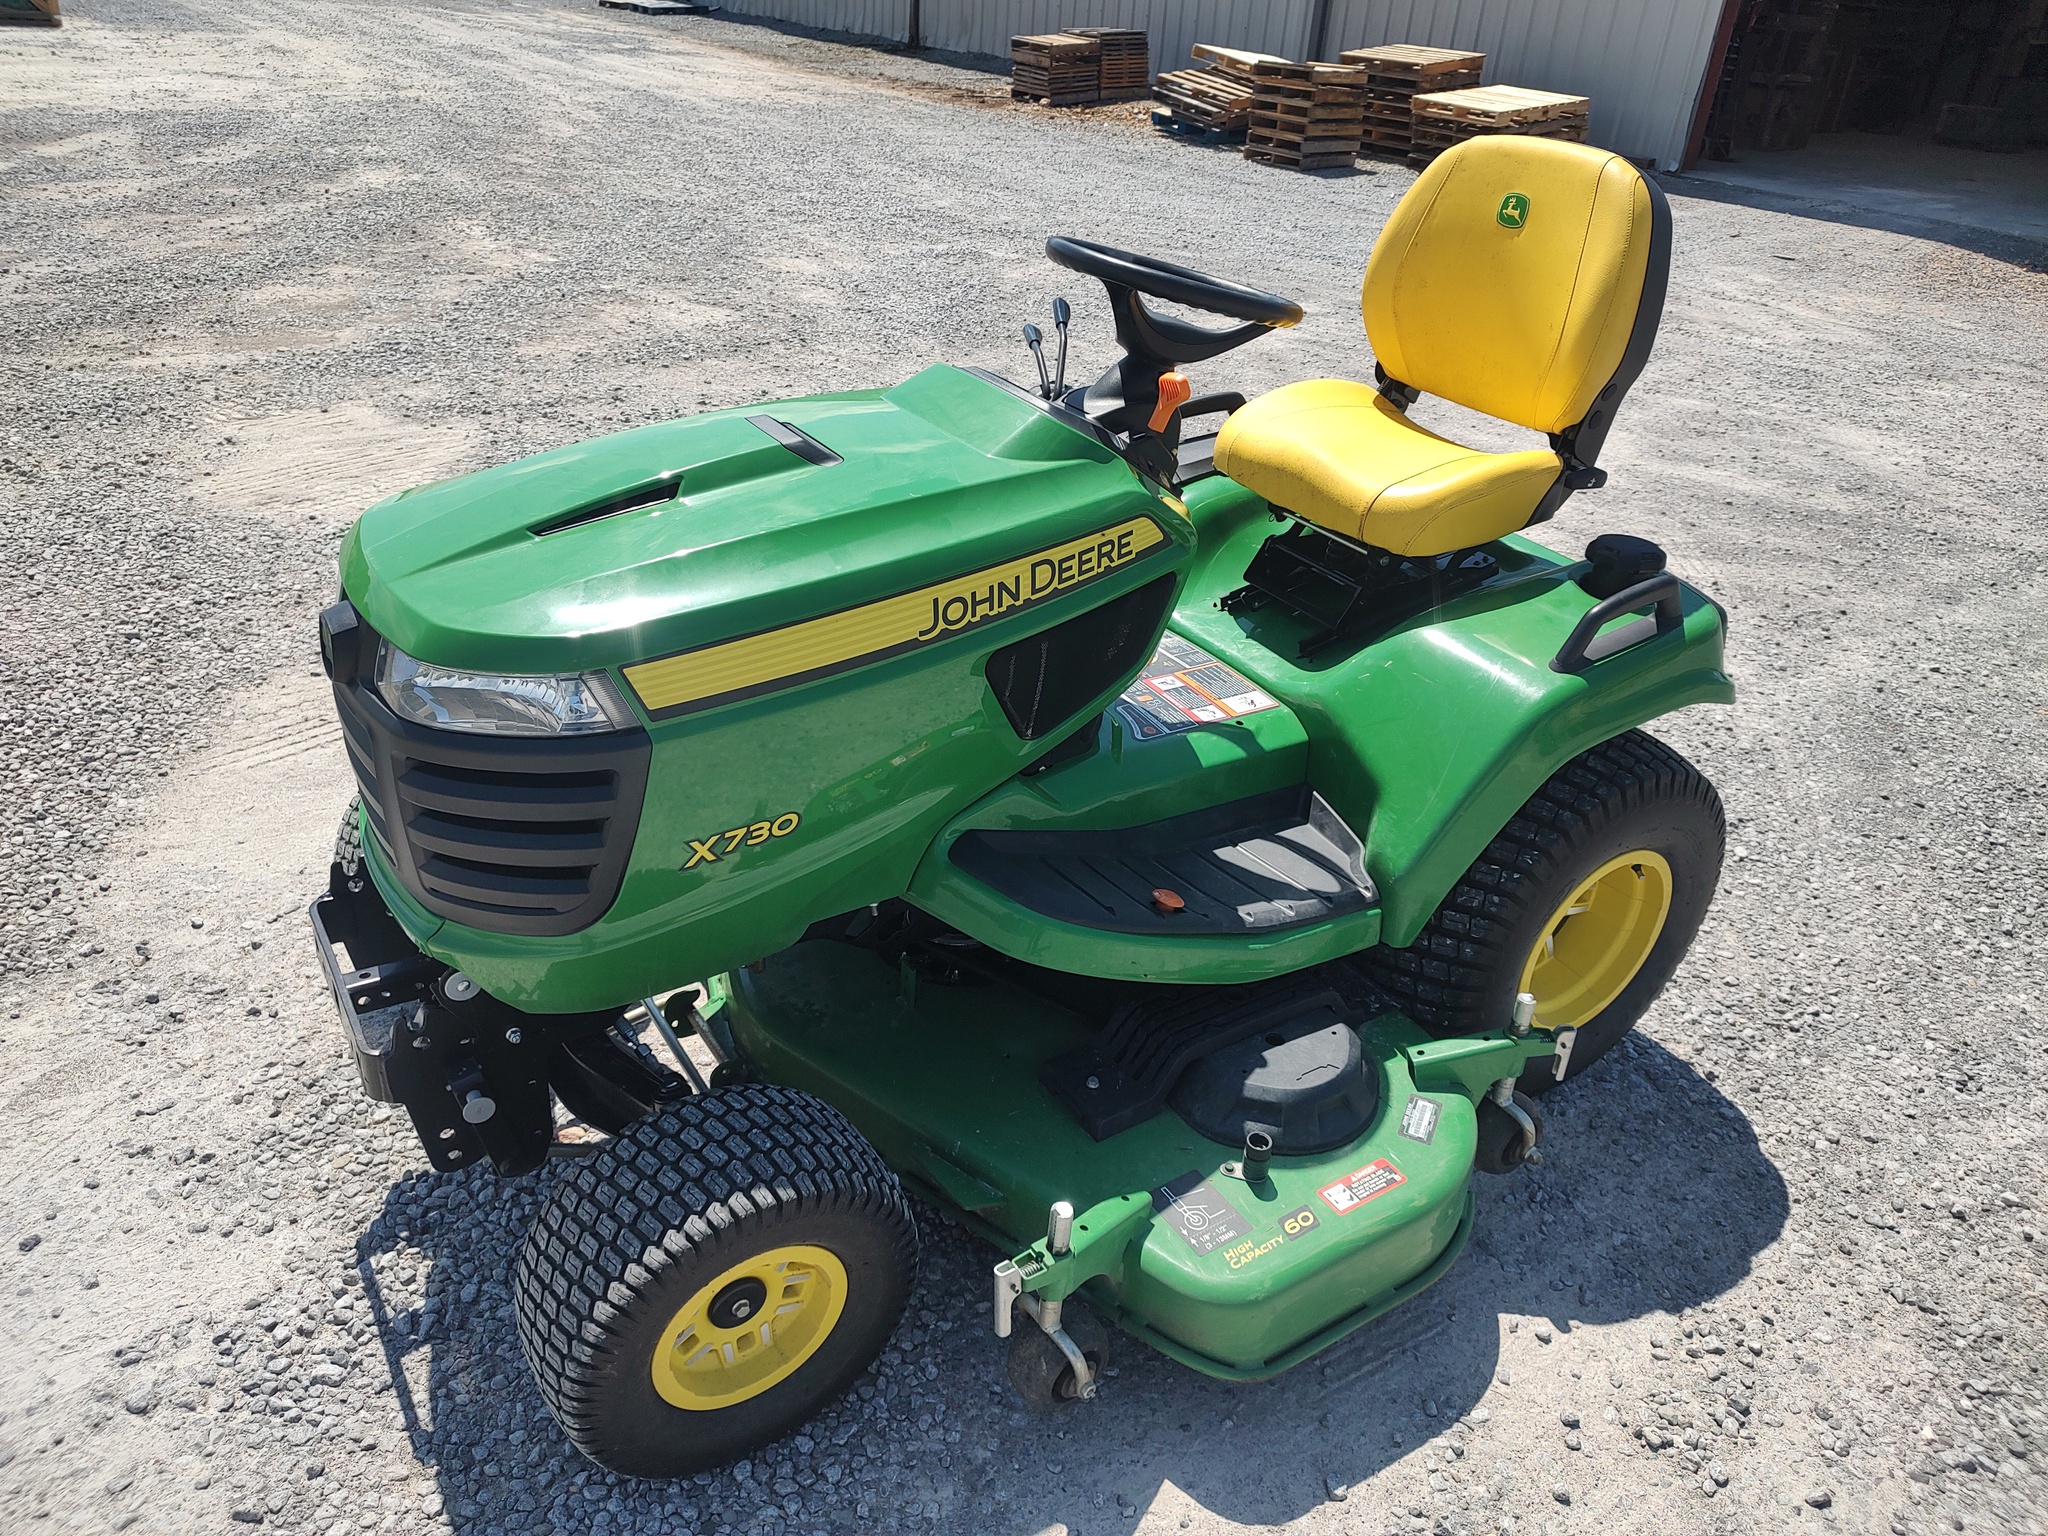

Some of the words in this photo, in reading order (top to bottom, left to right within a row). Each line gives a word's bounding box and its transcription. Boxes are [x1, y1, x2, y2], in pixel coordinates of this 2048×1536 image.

[917, 574, 1021, 640] JOHN
[1030, 529, 1135, 598] DEERE
[678, 811, 802, 872] X730
[1283, 1211, 1314, 1235] 60
[1223, 1240, 1254, 1261] HIGH
[1229, 1235, 1285, 1270] CAPACITY
